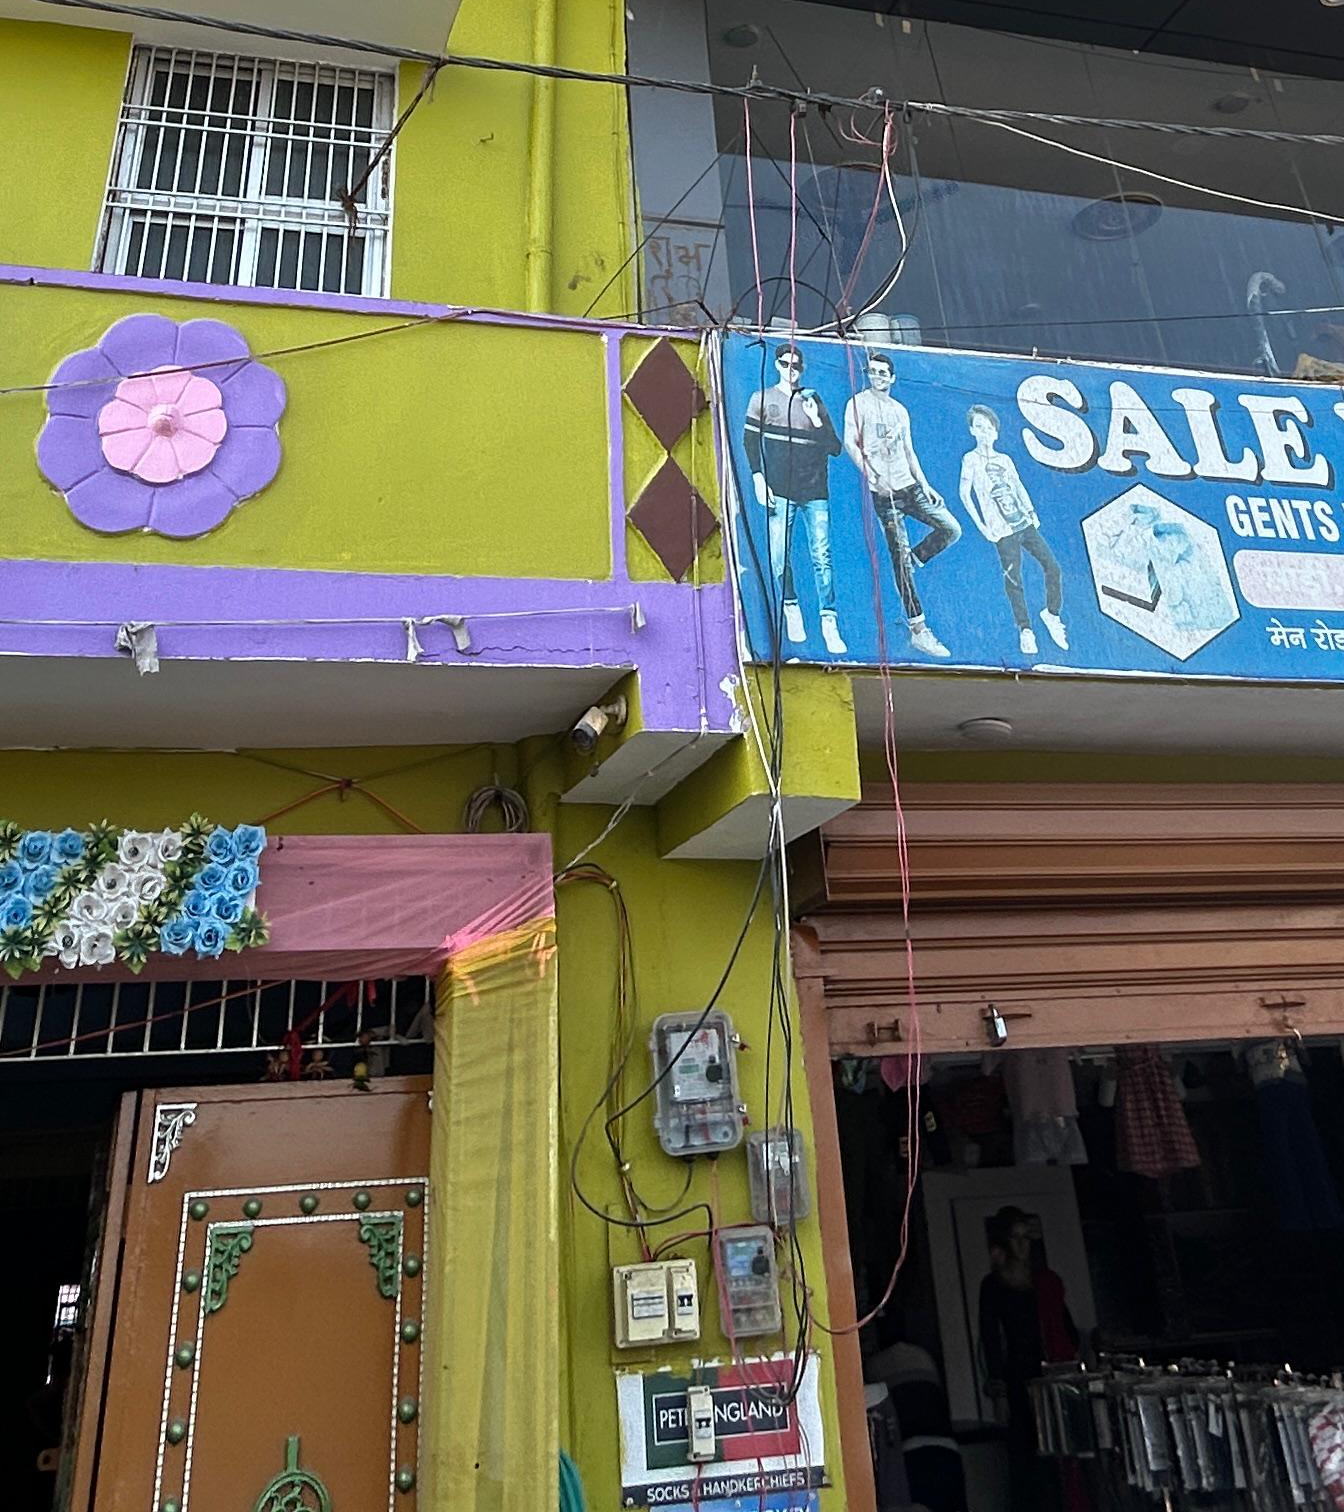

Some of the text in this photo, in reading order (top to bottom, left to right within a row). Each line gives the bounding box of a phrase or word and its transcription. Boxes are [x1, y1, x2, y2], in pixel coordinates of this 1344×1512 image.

[1016, 374, 1334, 489] SALE
[1225, 495, 1341, 542] GENTS
[1266, 618, 1307, 649] मेन
[714, 1400, 784, 1423] NGLAND
[647, 1472, 806, 1504] SOCKS HANDKERCHIEFS
